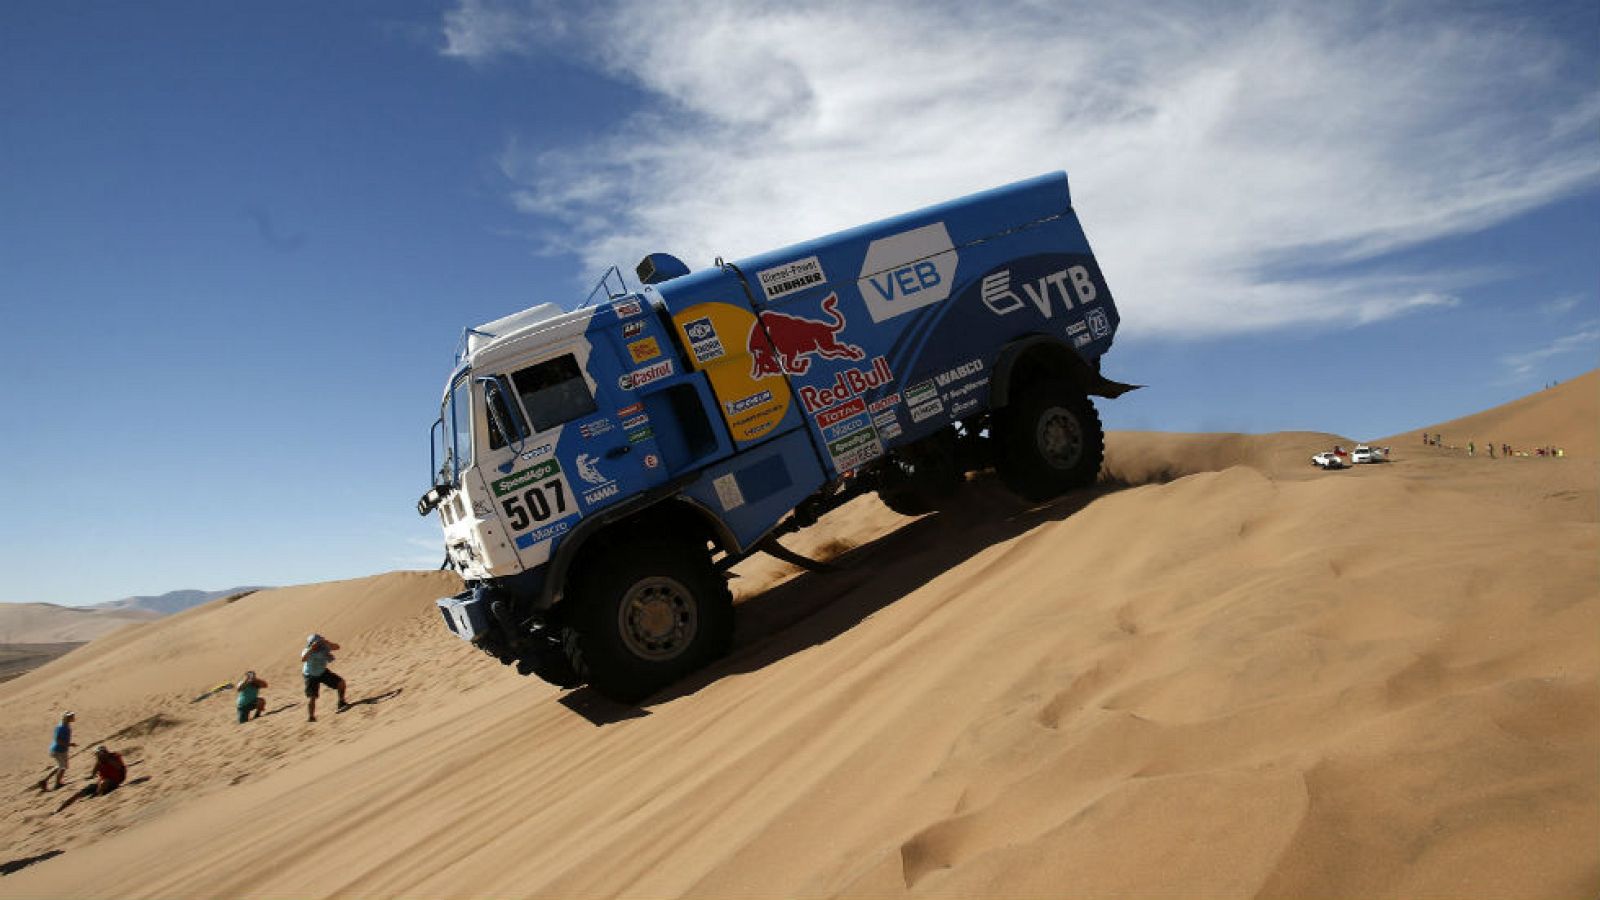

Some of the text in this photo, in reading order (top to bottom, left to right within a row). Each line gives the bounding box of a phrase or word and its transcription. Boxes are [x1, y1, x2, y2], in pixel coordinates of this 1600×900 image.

[767, 273, 822, 296] LIEBHERR
[870, 261, 941, 301] VEB
[1023, 265, 1097, 318] VTB
[631, 364, 672, 387] Castrol
[800, 372, 849, 414] Red
[846, 355, 894, 395] Bull
[936, 359, 983, 386] WABCO
[823, 404, 862, 424] TOTAL
[499, 465, 551, 491] SpeedAgro
[502, 478, 567, 531] 507
[585, 485, 618, 504] KAMAZ
[531, 521, 568, 542] Macro
